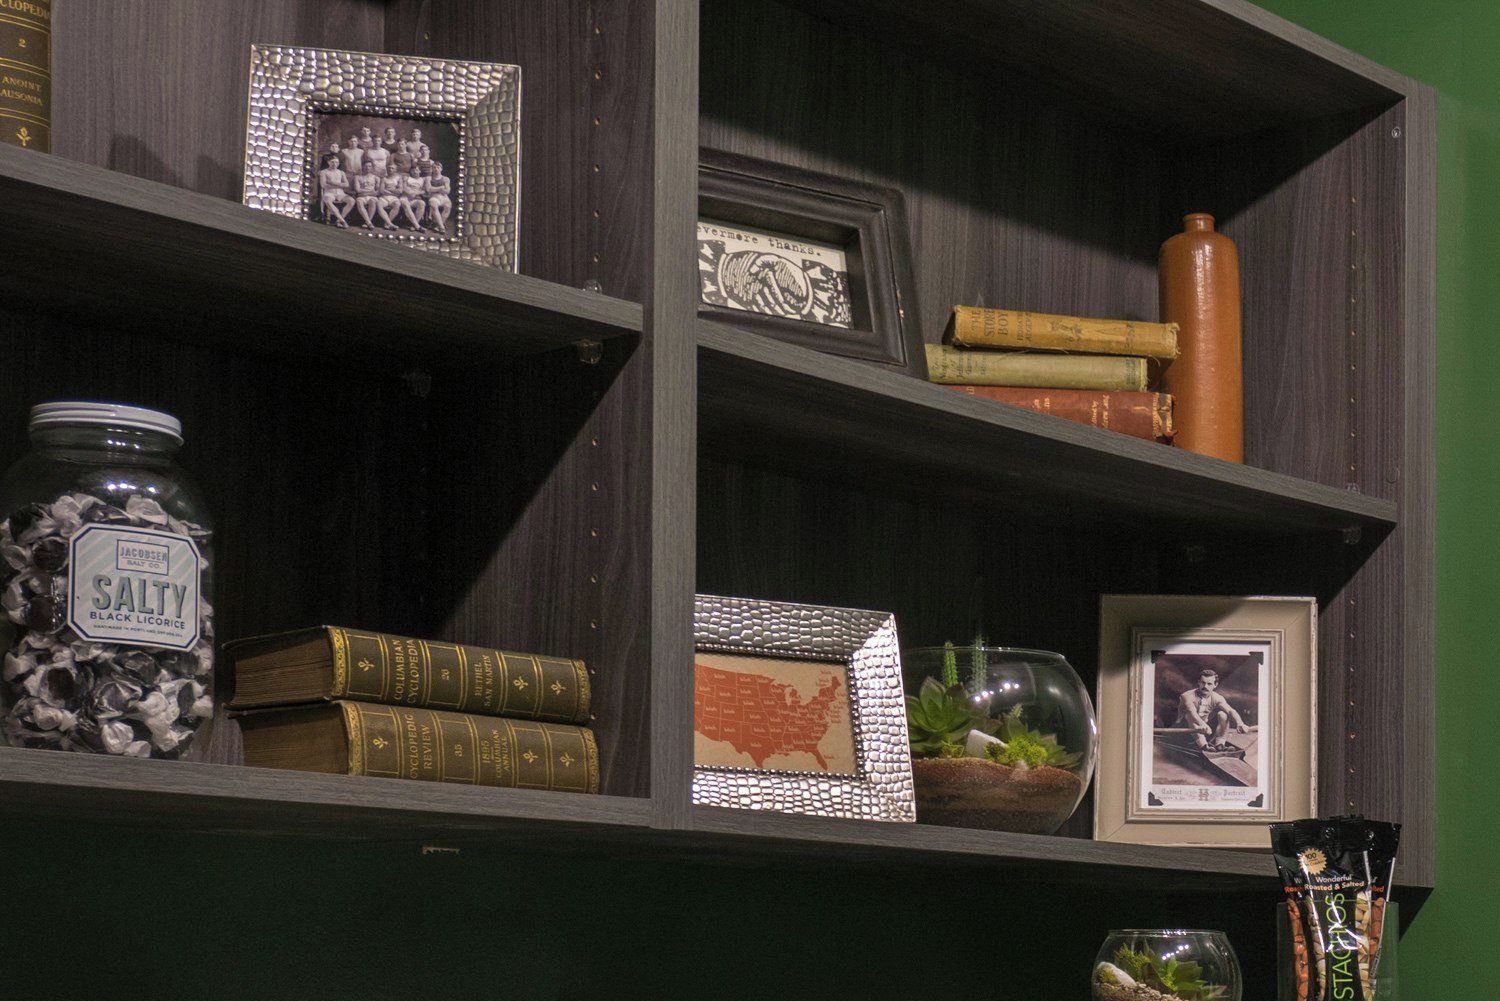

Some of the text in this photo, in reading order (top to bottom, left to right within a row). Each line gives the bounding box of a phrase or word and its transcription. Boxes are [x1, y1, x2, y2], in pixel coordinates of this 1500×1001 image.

[19, 38, 27, 48] 2
[768, 237, 822, 257] thanks.
[120, 546, 168, 562] JACOBSEN
[92, 574, 187, 619] SALTY
[89, 611, 186, 630] BLACK LICORICE
[392, 639, 405, 700] COLUMBIAN
[406, 639, 420, 704] CYCLOPEDIA
[405, 713, 418, 780] CYCLOPEDIC
[422, 724, 433, 770] REVIEW
[1304, 882, 1332, 891] Roasted
[1342, 881, 1365, 889] Salted
[1315, 875, 1352, 884] Wonderful
